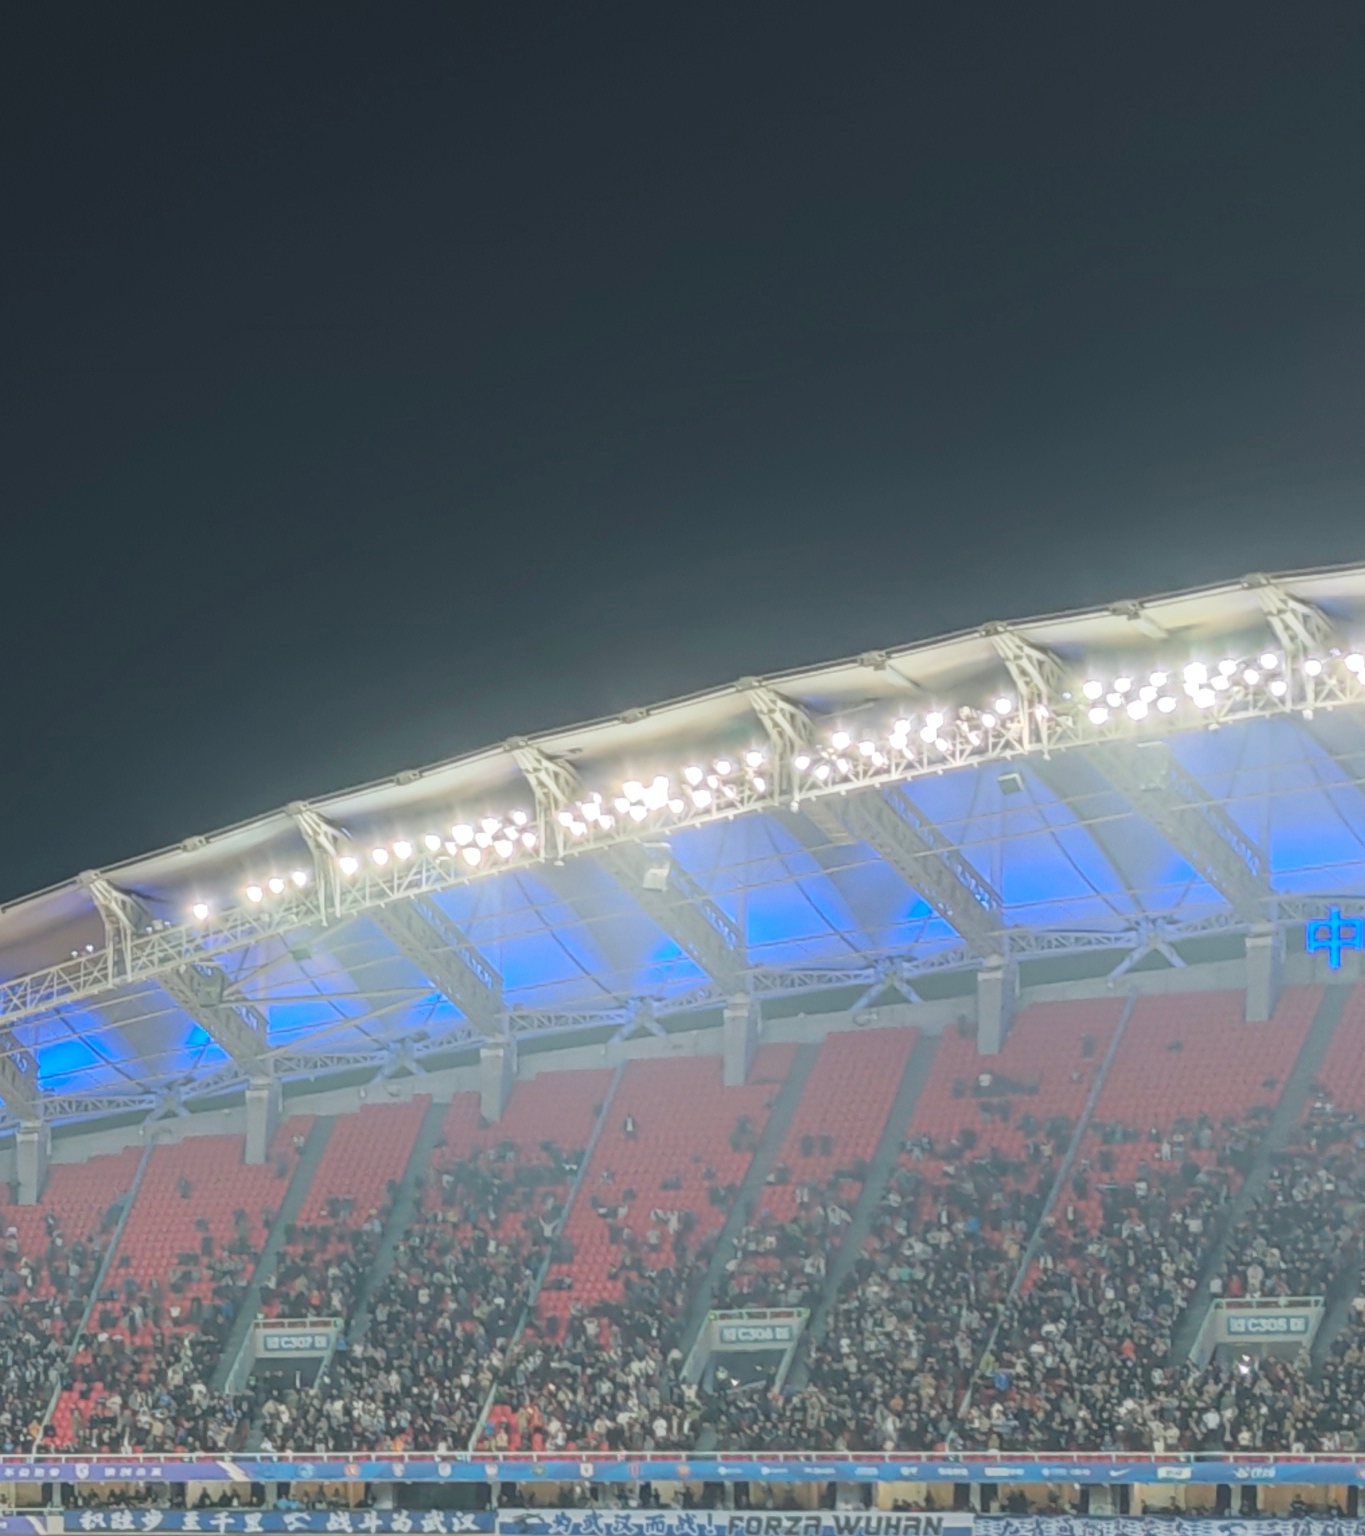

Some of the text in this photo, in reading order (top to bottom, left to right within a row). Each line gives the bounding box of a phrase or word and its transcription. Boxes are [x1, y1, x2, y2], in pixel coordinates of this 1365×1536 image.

[79, 1509, 480, 1534] 积跬步 至千里 战斗为武汉
[726, 1513, 822, 1536] FORZA
